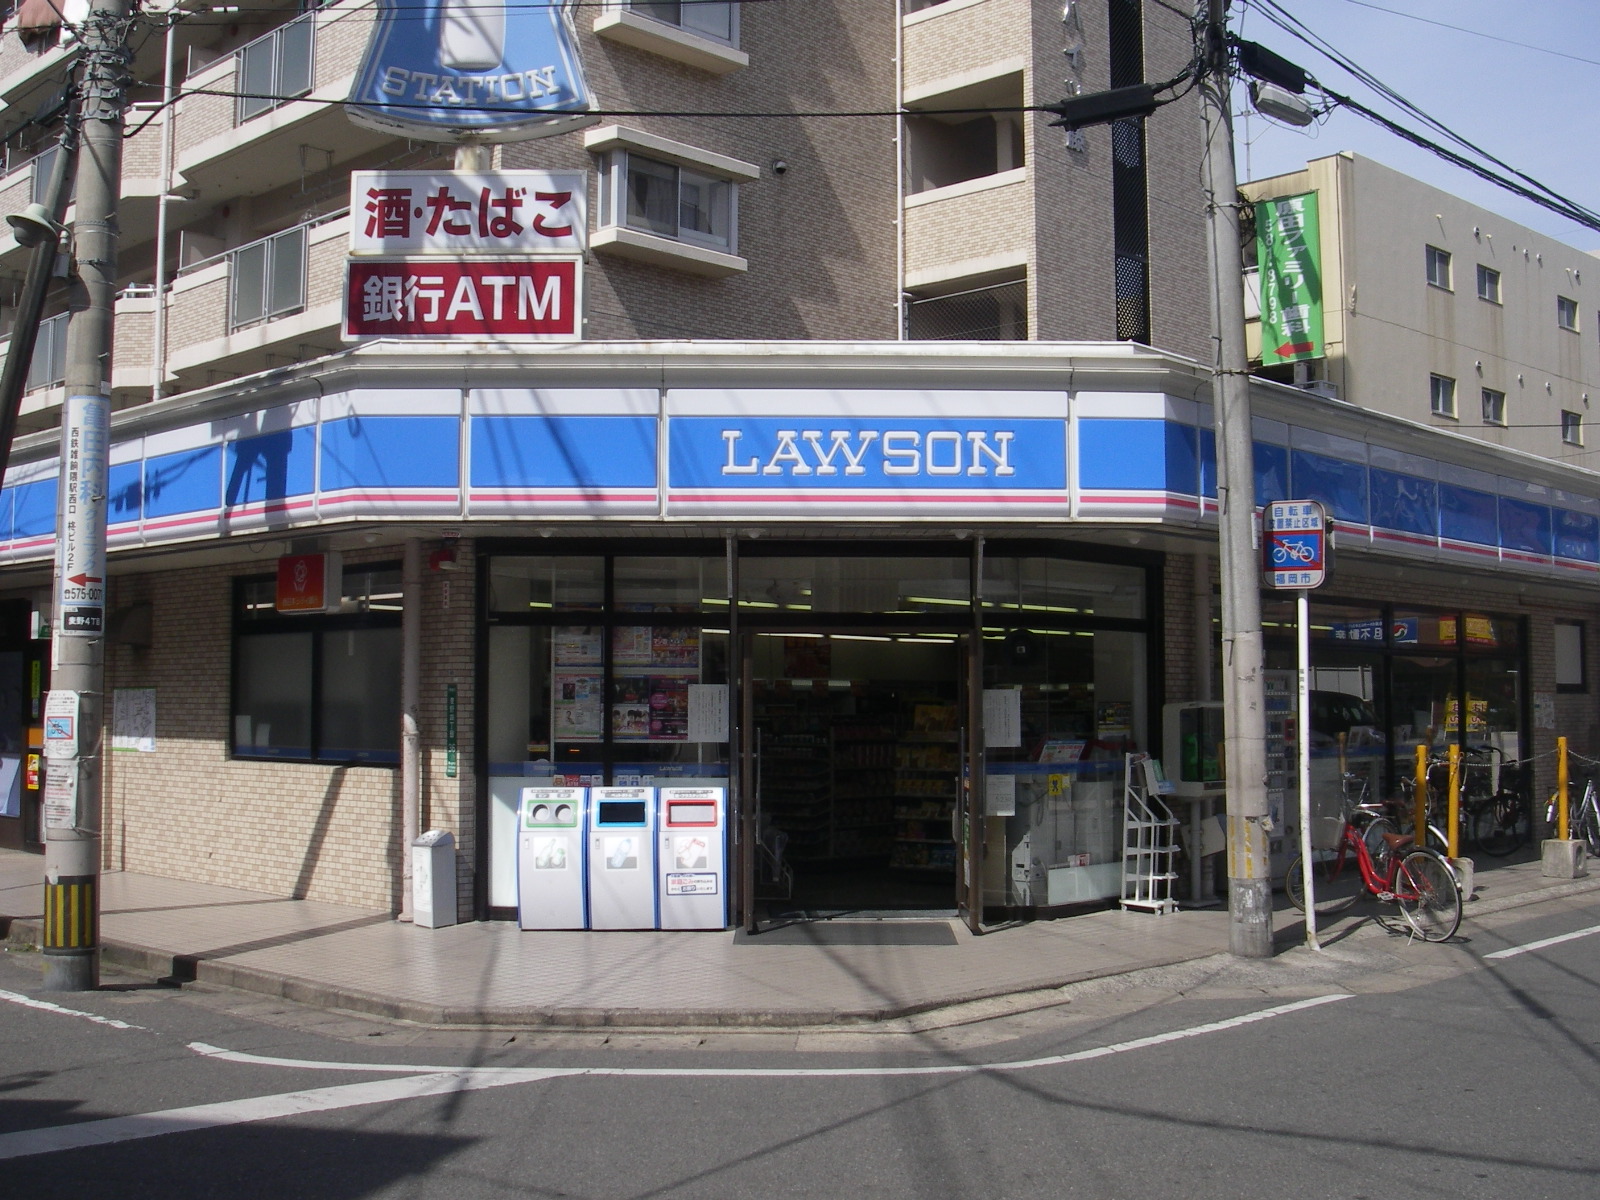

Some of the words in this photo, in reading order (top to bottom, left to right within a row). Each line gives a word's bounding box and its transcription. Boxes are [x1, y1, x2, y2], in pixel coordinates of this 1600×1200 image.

[382, 66, 561, 104] STATION
[362, 274, 561, 322] 銀行ATM
[721, 429, 1016, 477] LAWSON
[1268, 517, 1319, 529] 放置禁止区域
[1274, 505, 1312, 517] 自転車
[1276, 573, 1311, 584] 福岡市
